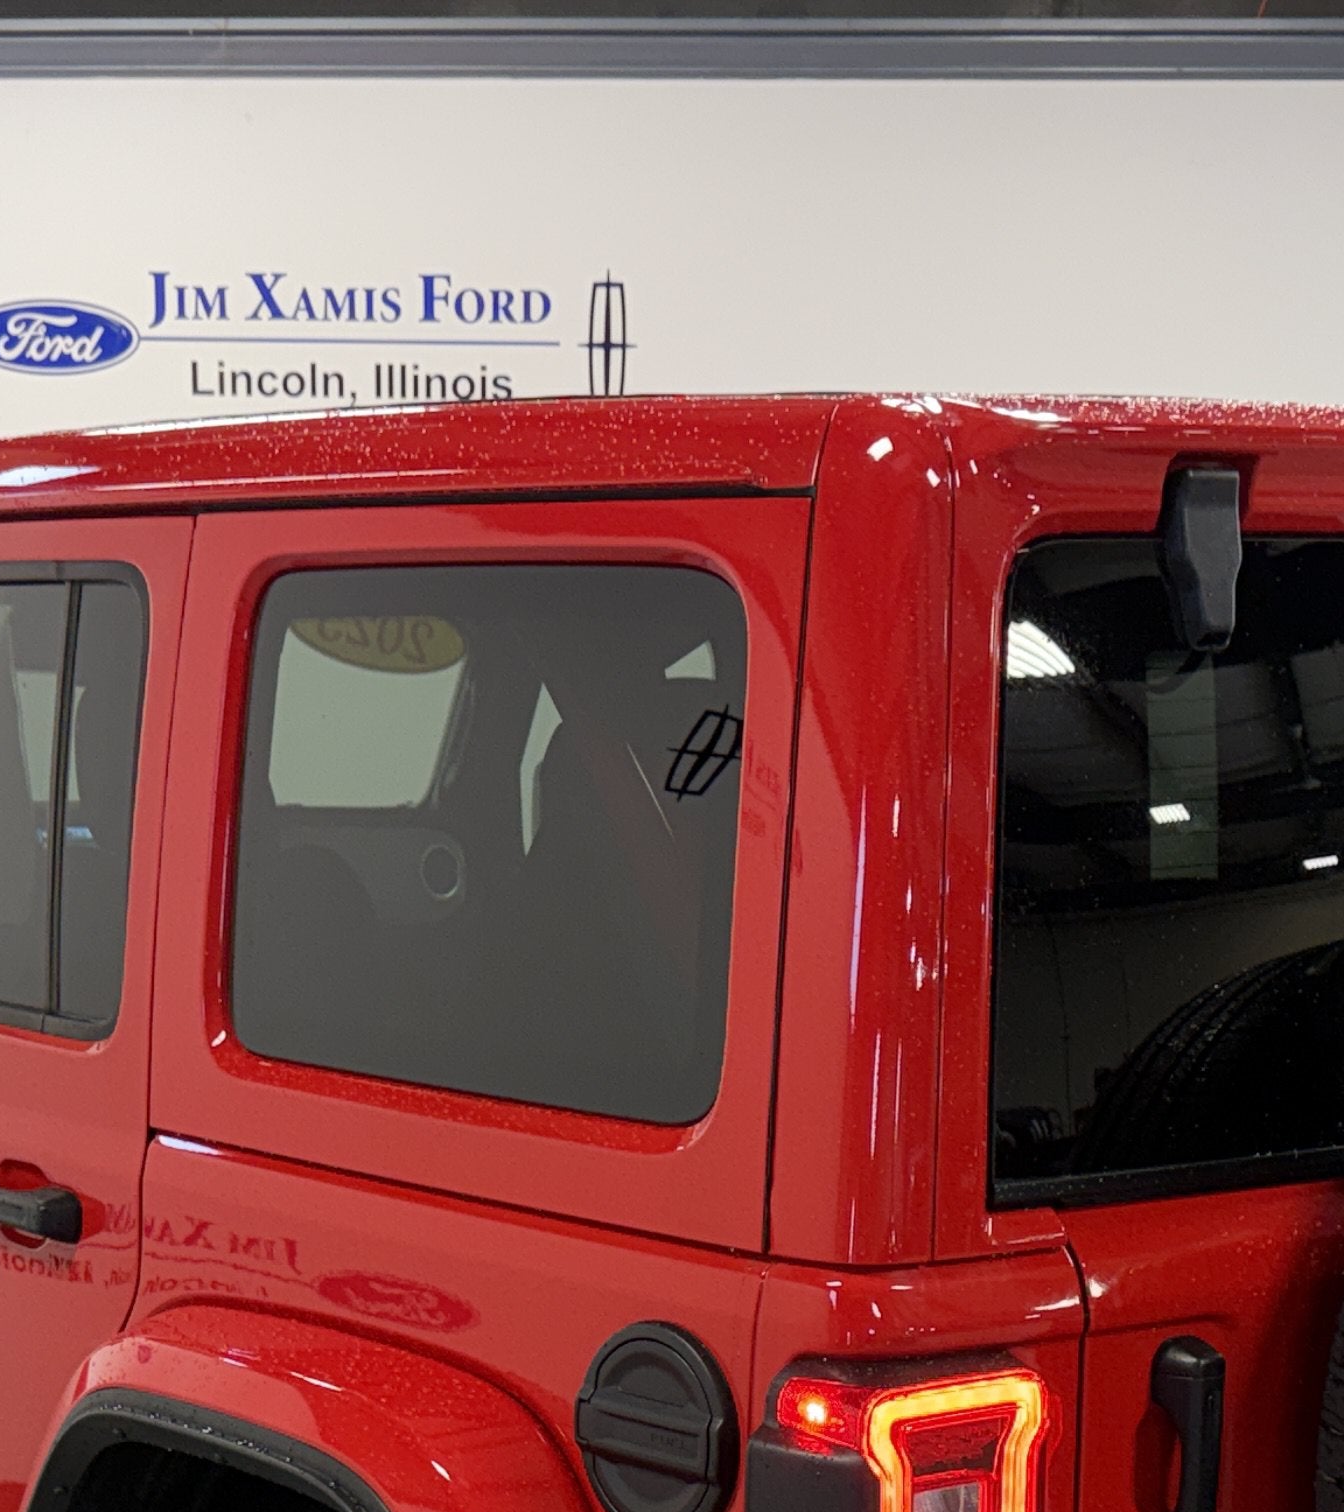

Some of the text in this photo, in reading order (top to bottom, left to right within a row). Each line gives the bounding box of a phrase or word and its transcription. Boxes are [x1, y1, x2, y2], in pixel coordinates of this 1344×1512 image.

[147, 271, 552, 329] JIM XAMIS FORD
[191, 361, 514, 406] Lincoln, Illinois
